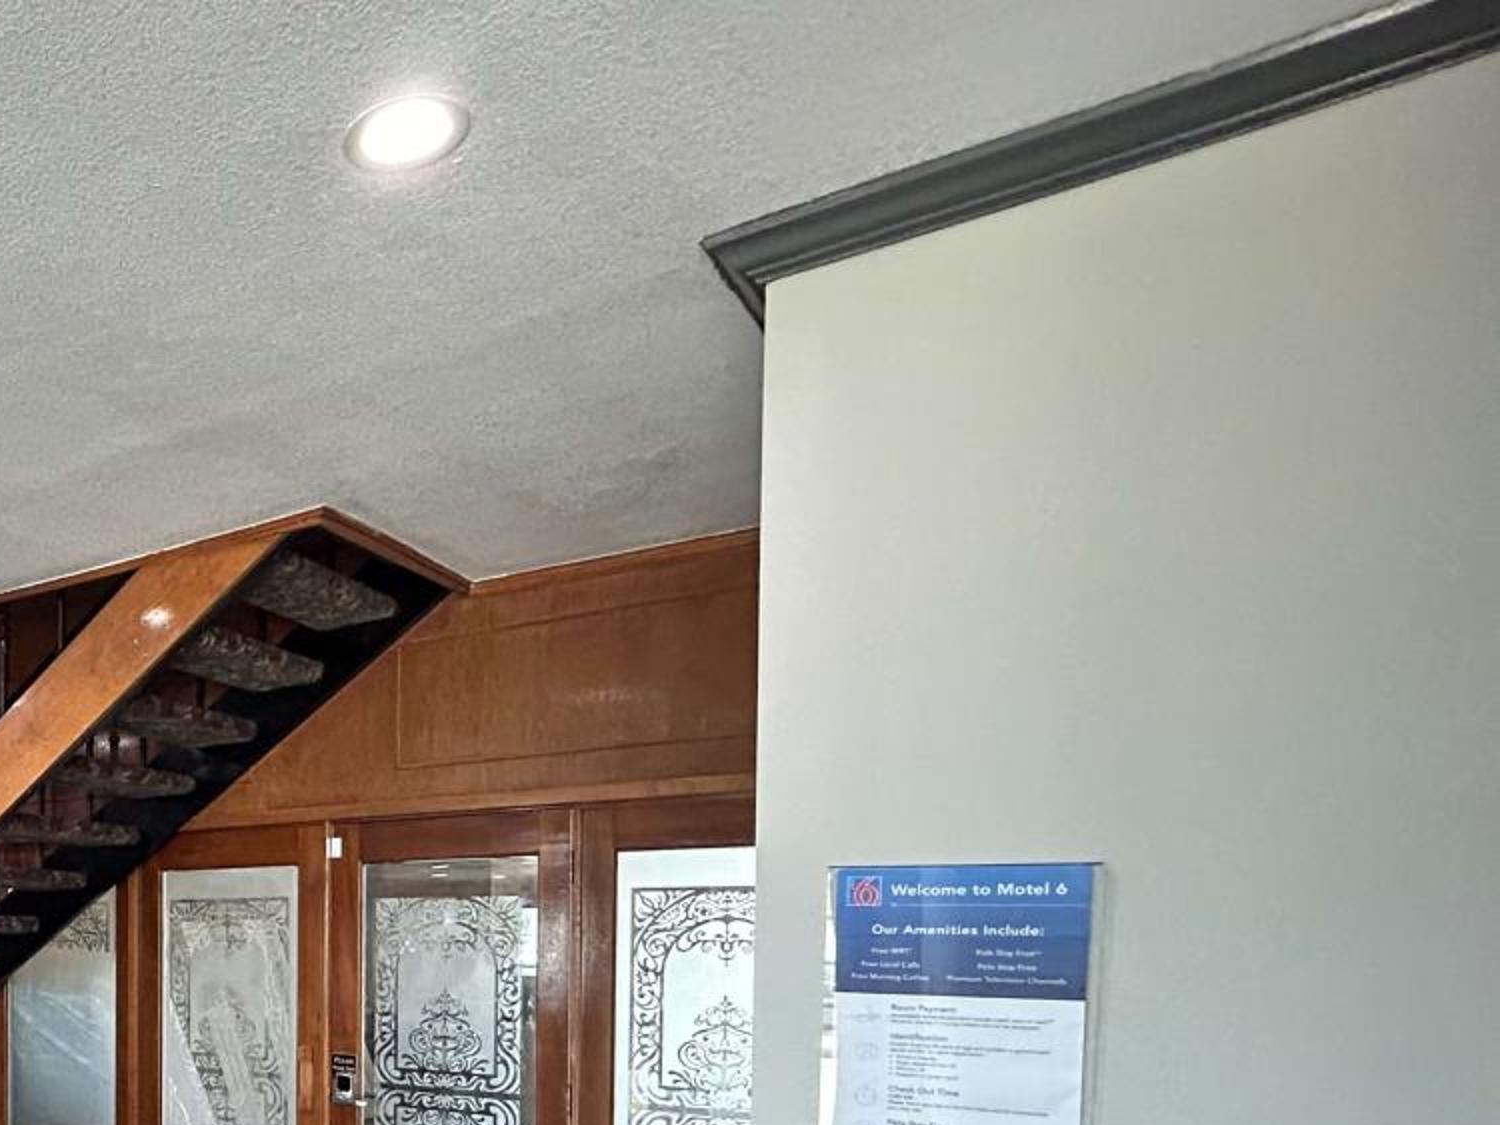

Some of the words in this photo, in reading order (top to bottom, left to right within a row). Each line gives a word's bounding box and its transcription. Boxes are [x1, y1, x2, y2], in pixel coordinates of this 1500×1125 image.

[891, 884, 966, 897] Welcome
[973, 885, 991, 896] to
[997, 882, 1049, 896] Motel
[1055, 883, 1068, 895] 6
[871, 923, 898, 936] Our
[903, 924, 978, 935] Amenities
